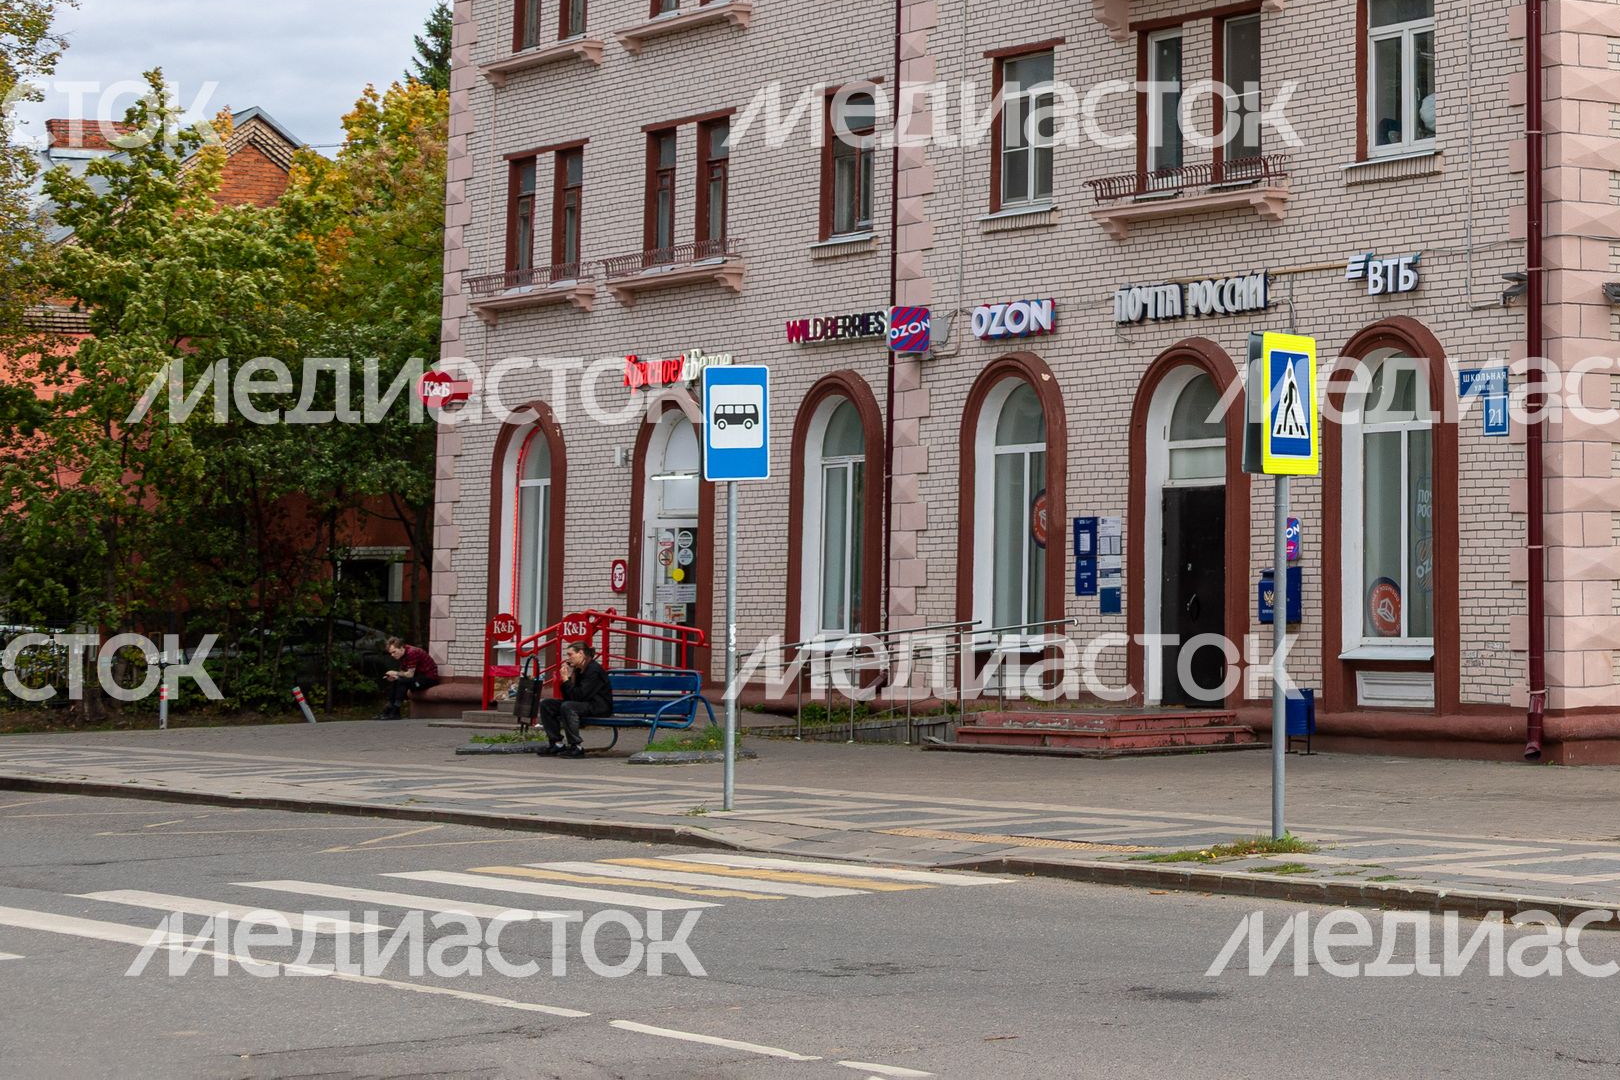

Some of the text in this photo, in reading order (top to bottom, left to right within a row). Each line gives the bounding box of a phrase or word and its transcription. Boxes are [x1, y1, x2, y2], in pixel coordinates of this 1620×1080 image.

[1368, 257, 1415, 295] ВТБ
[1114, 273, 1265, 322] ПОЧТА РОССИИ
[786, 311, 888, 344] WILDBERRIES
[971, 299, 1052, 337] OZON
[890, 319, 930, 339] OZON
[1463, 371, 1507, 383] ШКОЛЬНАЯ
[1488, 408, 1504, 427] 21
[1285, 523, 1300, 539] ON
[493, 620, 515, 634] К&Б
[563, 621, 587, 636] К&Б
